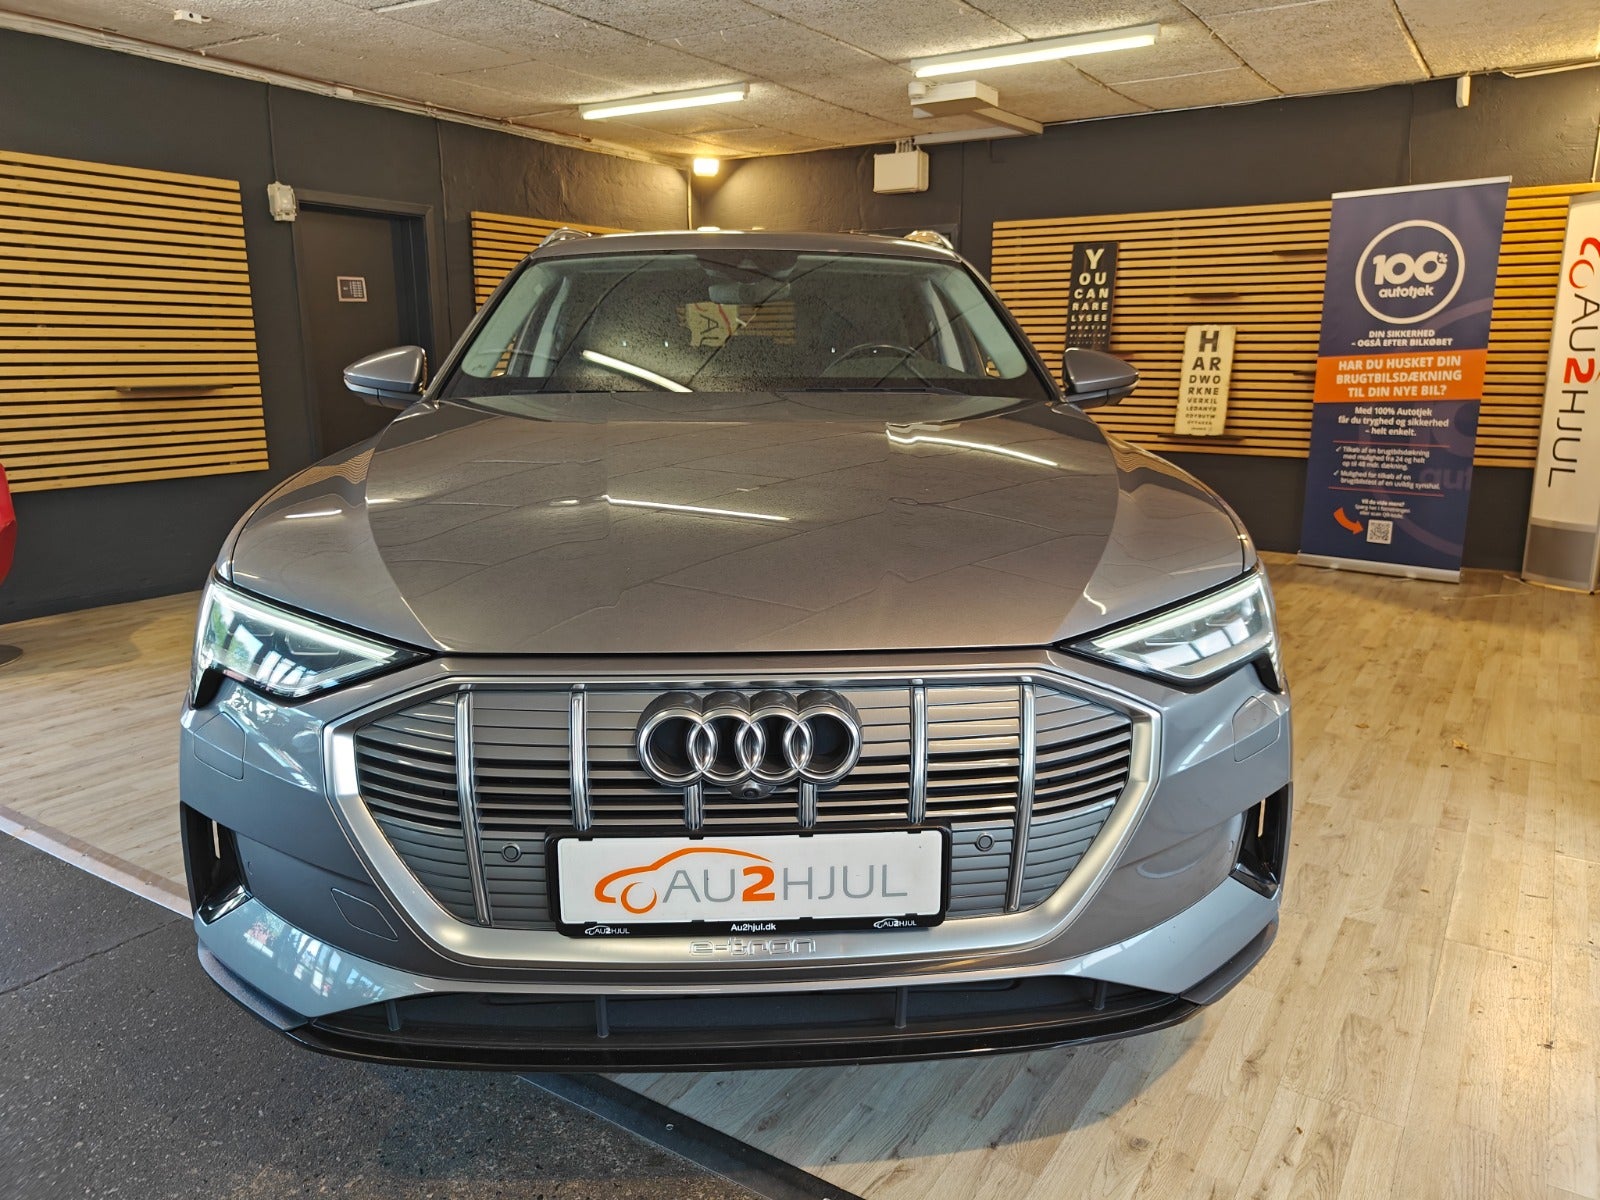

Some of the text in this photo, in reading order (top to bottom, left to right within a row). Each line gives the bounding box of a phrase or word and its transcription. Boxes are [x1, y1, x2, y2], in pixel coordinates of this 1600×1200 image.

[1085, 248, 1105, 269] Y
[1372, 251, 1448, 286] 100%
[1079, 271, 1107, 286] OU
[1073, 287, 1109, 299] CAN
[1071, 301, 1108, 311] RARE
[1070, 313, 1107, 323] LYSEE
[1368, 329, 1435, 338] DIN SIKKERHED
[1199, 330, 1219, 353] H
[1357, 338, 1381, 347] OGSÅ
[1383, 338, 1408, 347] EFTER
[1409, 337, 1453, 346] BILKØBET
[1192, 356, 1221, 371] AR
[1338, 355, 1462, 371] HAR DU HUSKET DIN
[1189, 374, 1221, 384] DWO
[1336, 370, 1462, 385] BRUGTBILSDÆKNING
[1187, 386, 1219, 396] RKNE
[1347, 384, 1447, 398] TIL DIN NYE BIL?
[1548, 293, 1600, 488] AU2HJUL
[1354, 406, 1433, 418] Med 100% Autotjek
[1338, 415, 1449, 428] får du tryghed og sikkerhed
[1370, 427, 1387, 435] helt
[661, 863, 909, 904] AU2HJUL
[730, 922, 777, 932] Au2hjul.dk
[883, 919, 918, 928] AU2HJUL
[594, 927, 631, 936] AU2HJUL
[689, 936, 817, 956] e-tron
